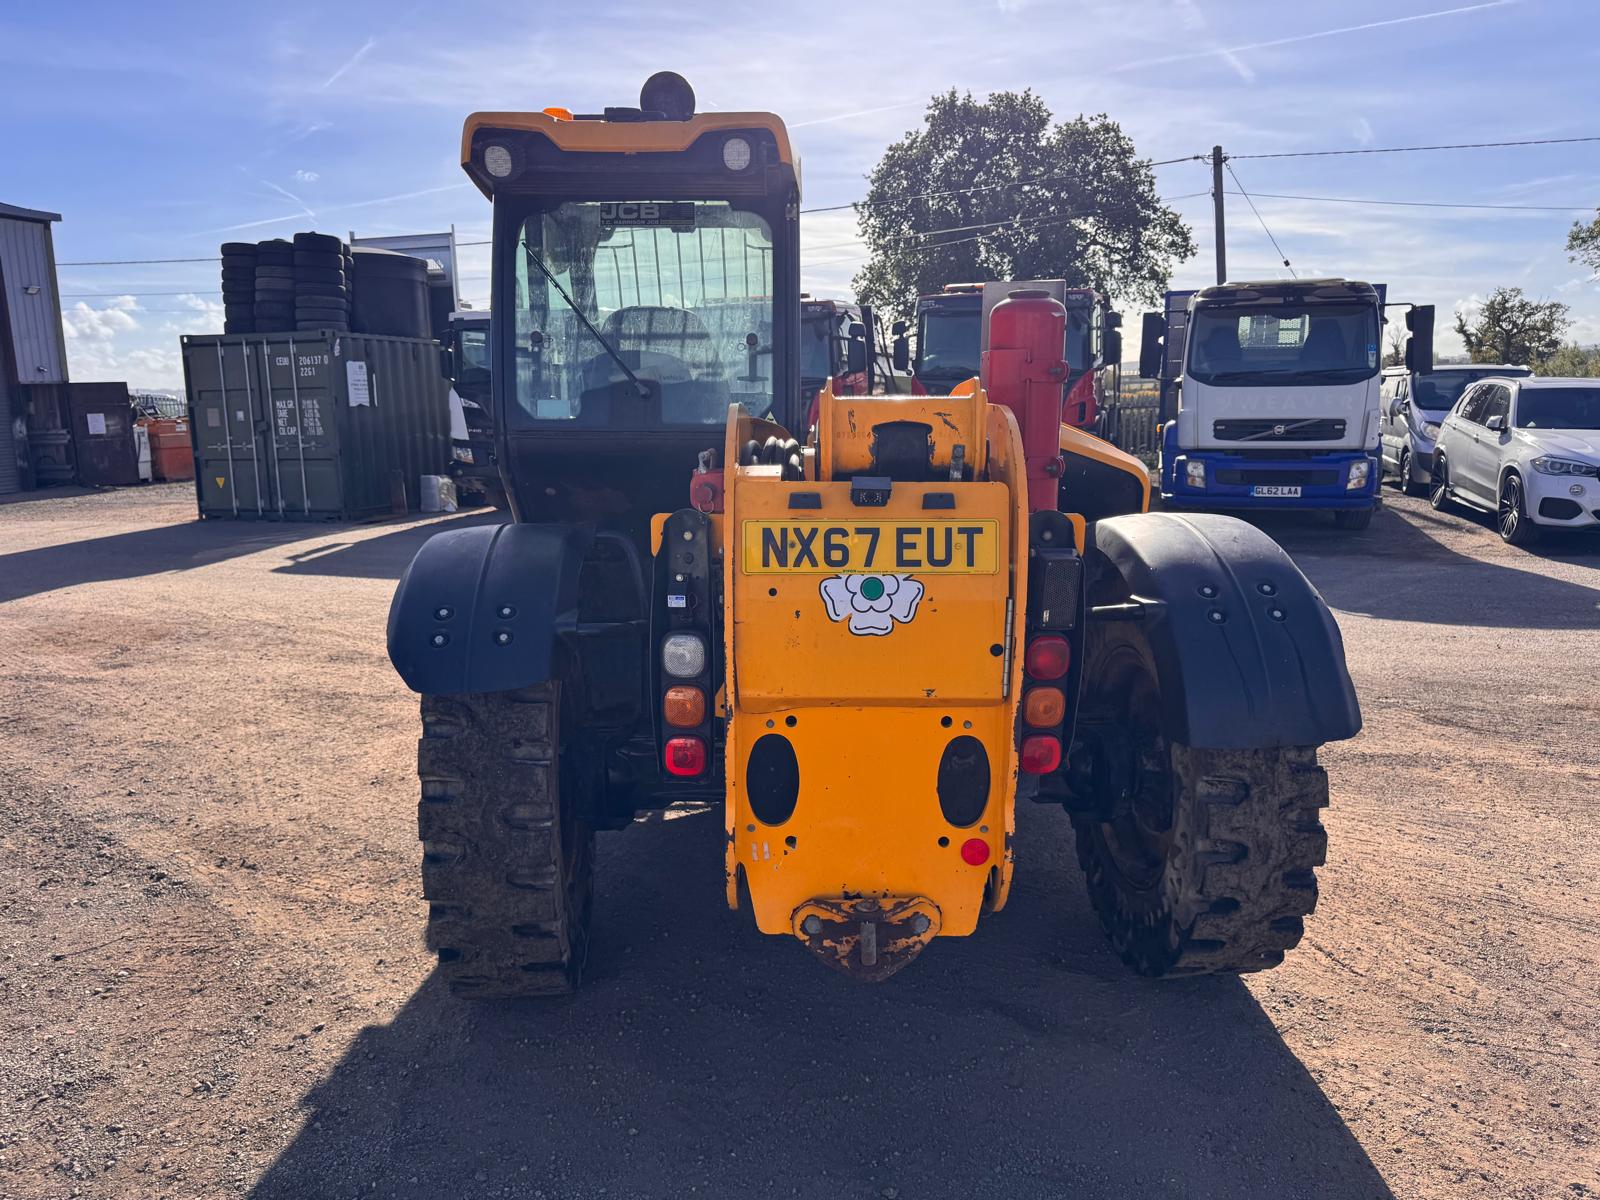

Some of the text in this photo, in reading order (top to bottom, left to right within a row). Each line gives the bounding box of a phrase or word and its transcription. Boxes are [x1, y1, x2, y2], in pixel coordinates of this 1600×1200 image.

[601, 203, 660, 219] JCB
[299, 356, 321, 366] 206137
[1255, 487, 1299, 496] GL62 LAA
[762, 527, 984, 568] NX67 EUT
